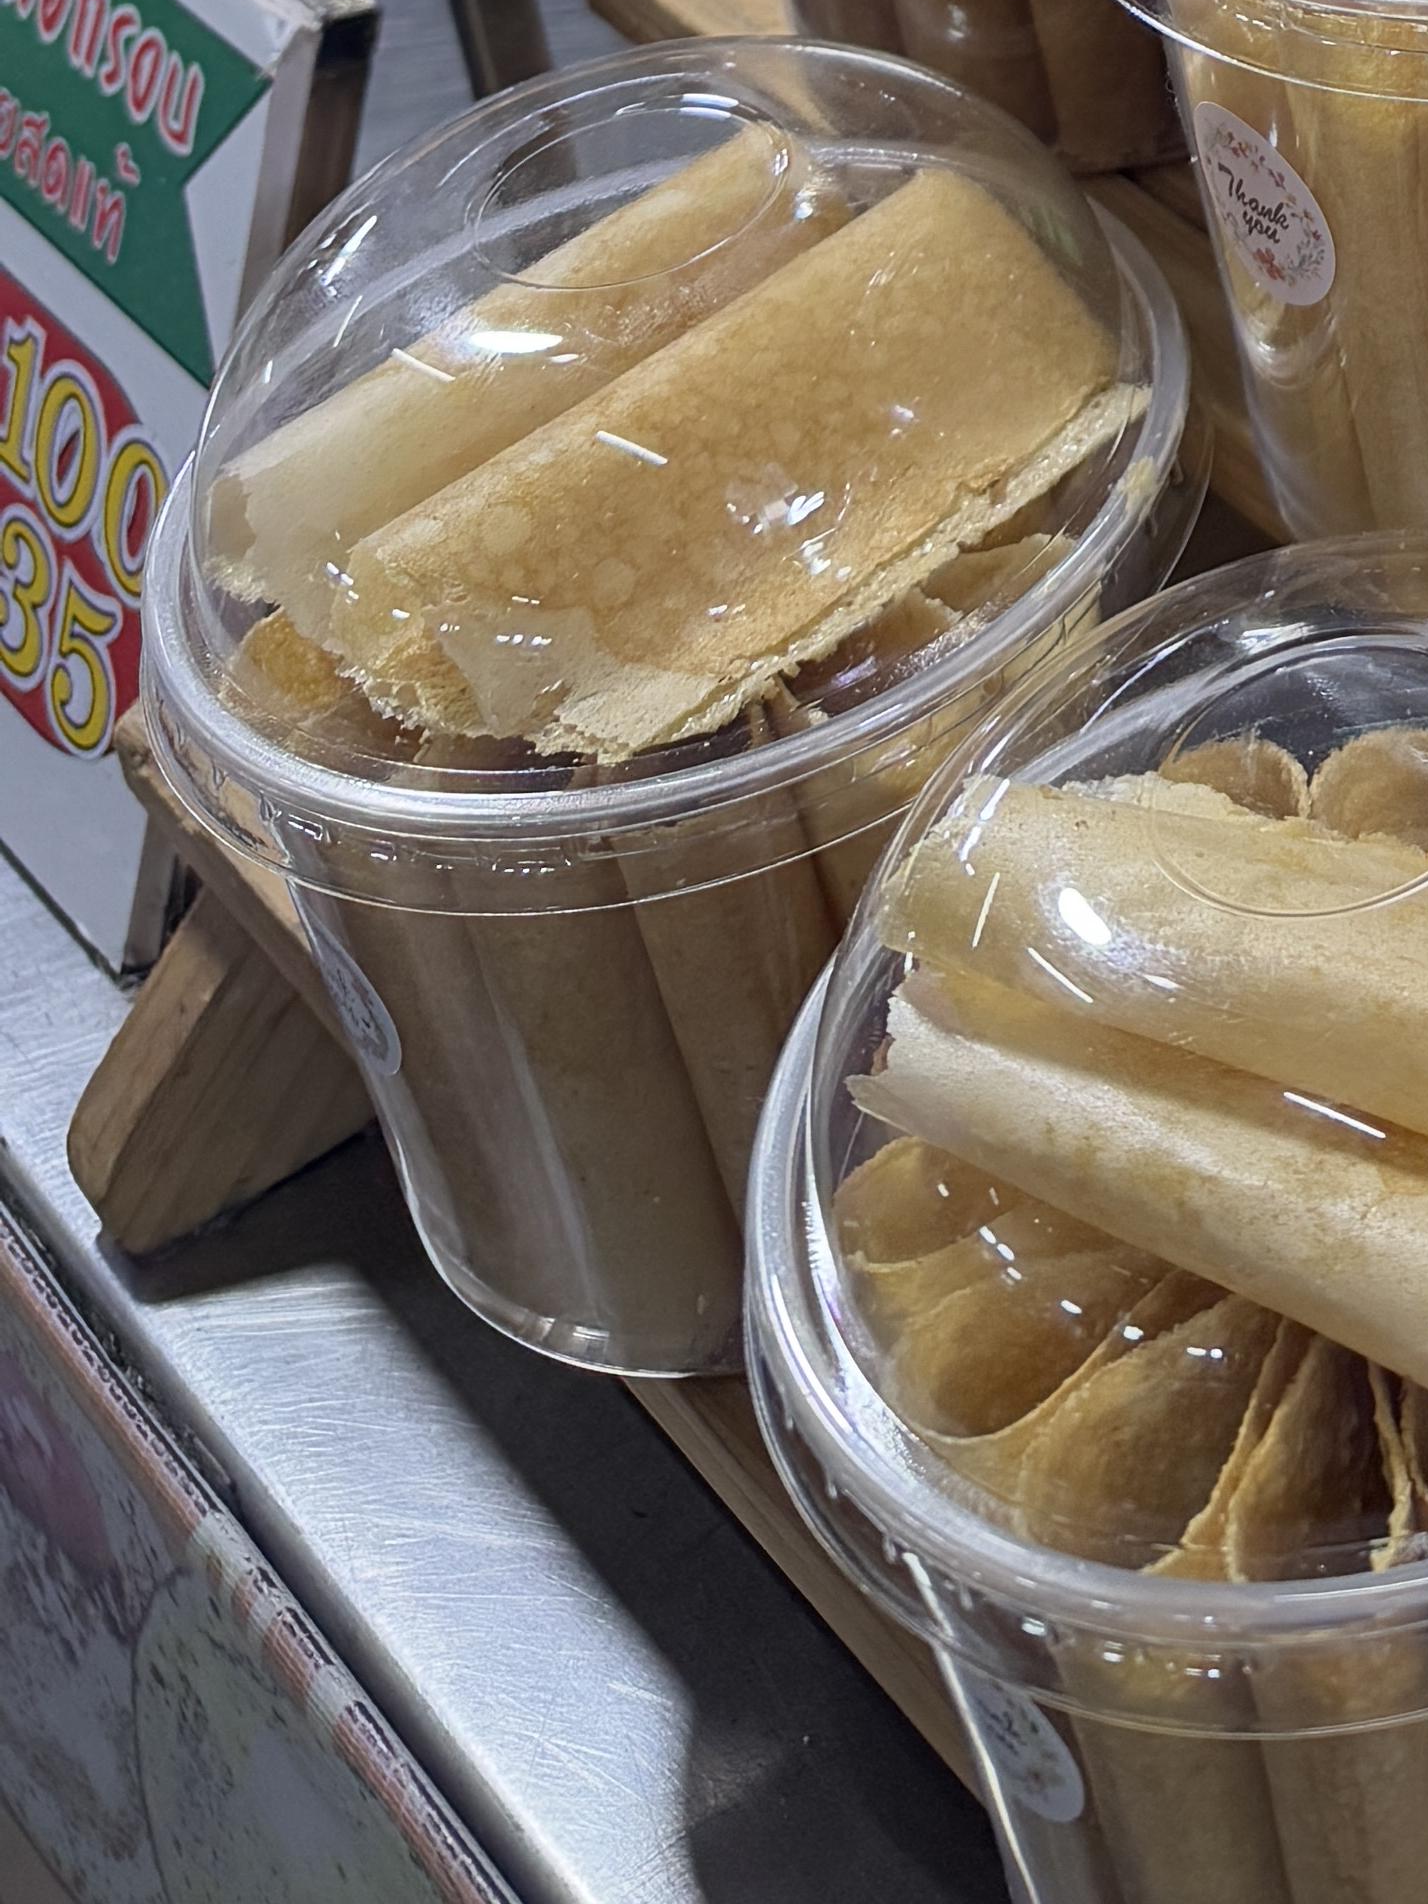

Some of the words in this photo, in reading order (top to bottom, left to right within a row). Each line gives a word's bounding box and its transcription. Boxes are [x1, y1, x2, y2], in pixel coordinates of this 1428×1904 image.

[1217, 161, 1290, 231] Thank
[1242, 212, 1281, 245] you
[0, 512, 120, 754] 35
